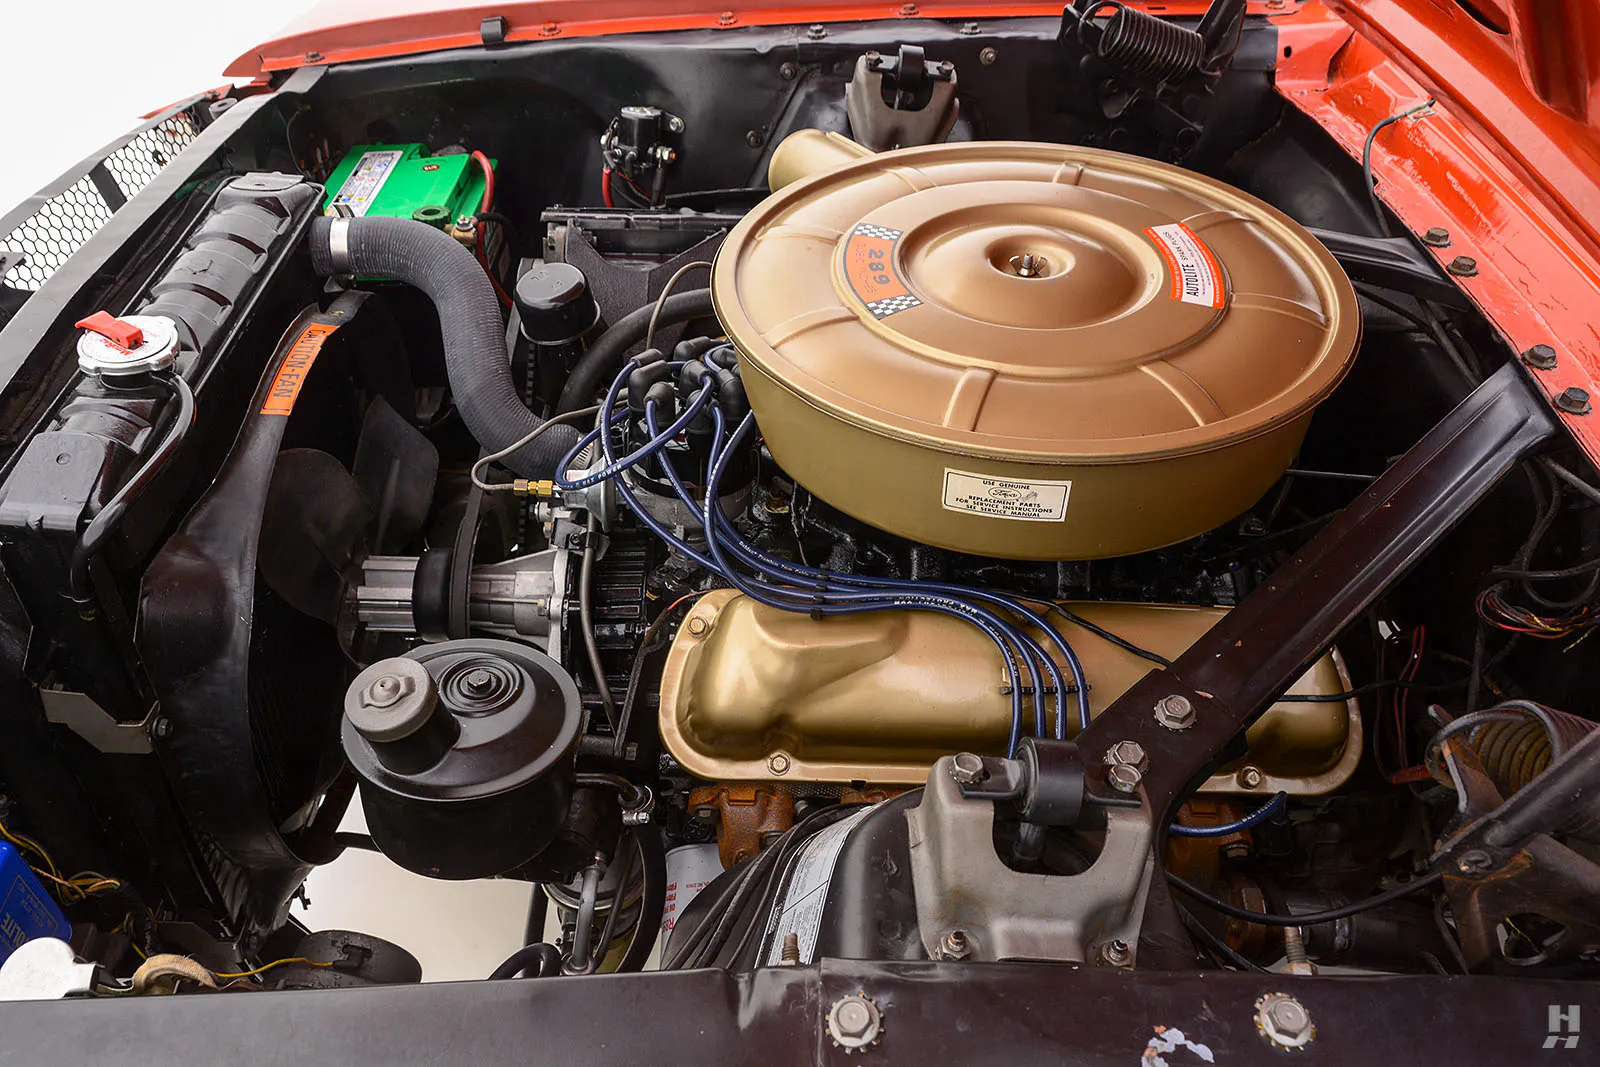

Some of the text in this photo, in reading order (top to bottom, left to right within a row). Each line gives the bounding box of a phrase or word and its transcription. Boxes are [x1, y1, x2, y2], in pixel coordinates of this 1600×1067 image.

[868, 249, 890, 285] 289
[1182, 264, 1199, 297] AUTOLITE
[598, 463, 623, 483] POWER
[999, 481, 1030, 490] GENUINE
[968, 495, 1016, 506] REPLACEMENT
[973, 500, 999, 509] SERVICE
[1003, 504, 1053, 513] INSTRUCTIONS
[980, 506, 1006, 514] SERVICE
[1, 911, 27, 948] OLITE
